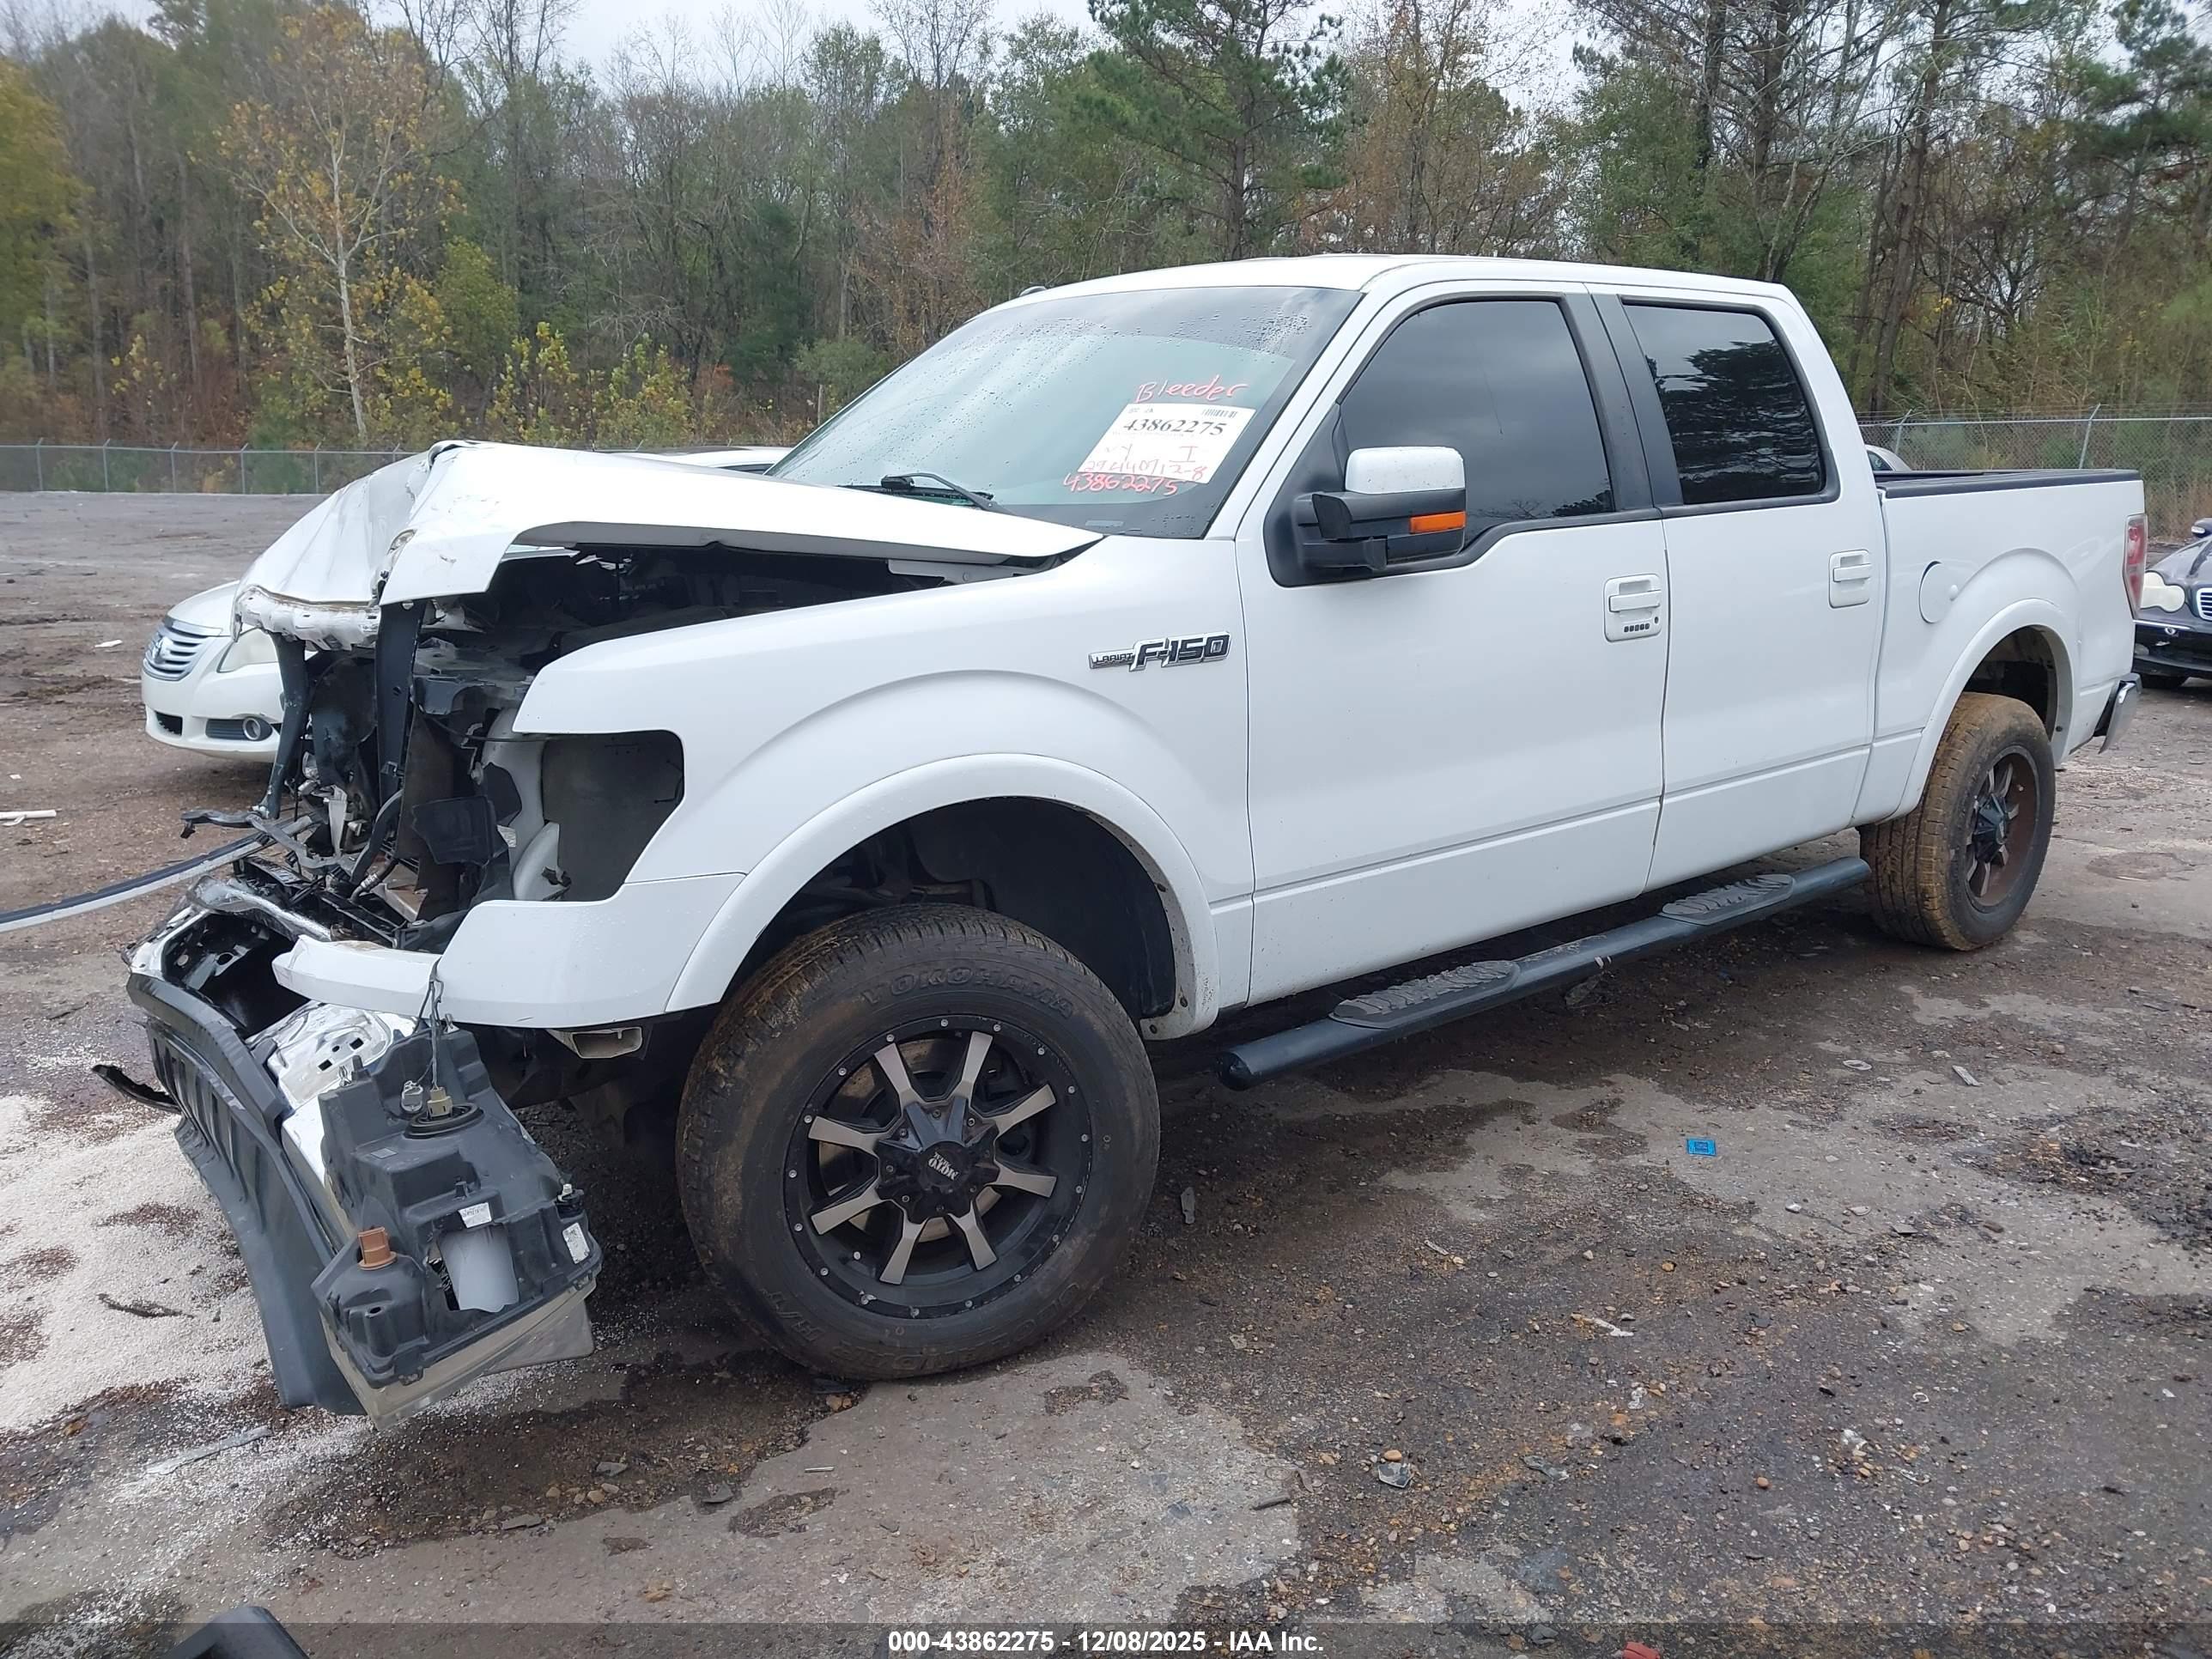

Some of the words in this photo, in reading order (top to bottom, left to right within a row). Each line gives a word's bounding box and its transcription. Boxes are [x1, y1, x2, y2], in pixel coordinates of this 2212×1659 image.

[1135, 374, 1249, 403] Bleeder
[1123, 418, 1227, 436] 43862275
[1063, 472, 1177, 496] 43862275
[1094, 651, 1134, 664] LARIAT
[1132, 632, 1231, 669] F-150
[861, 966, 1074, 1019] YOKOHAMA
